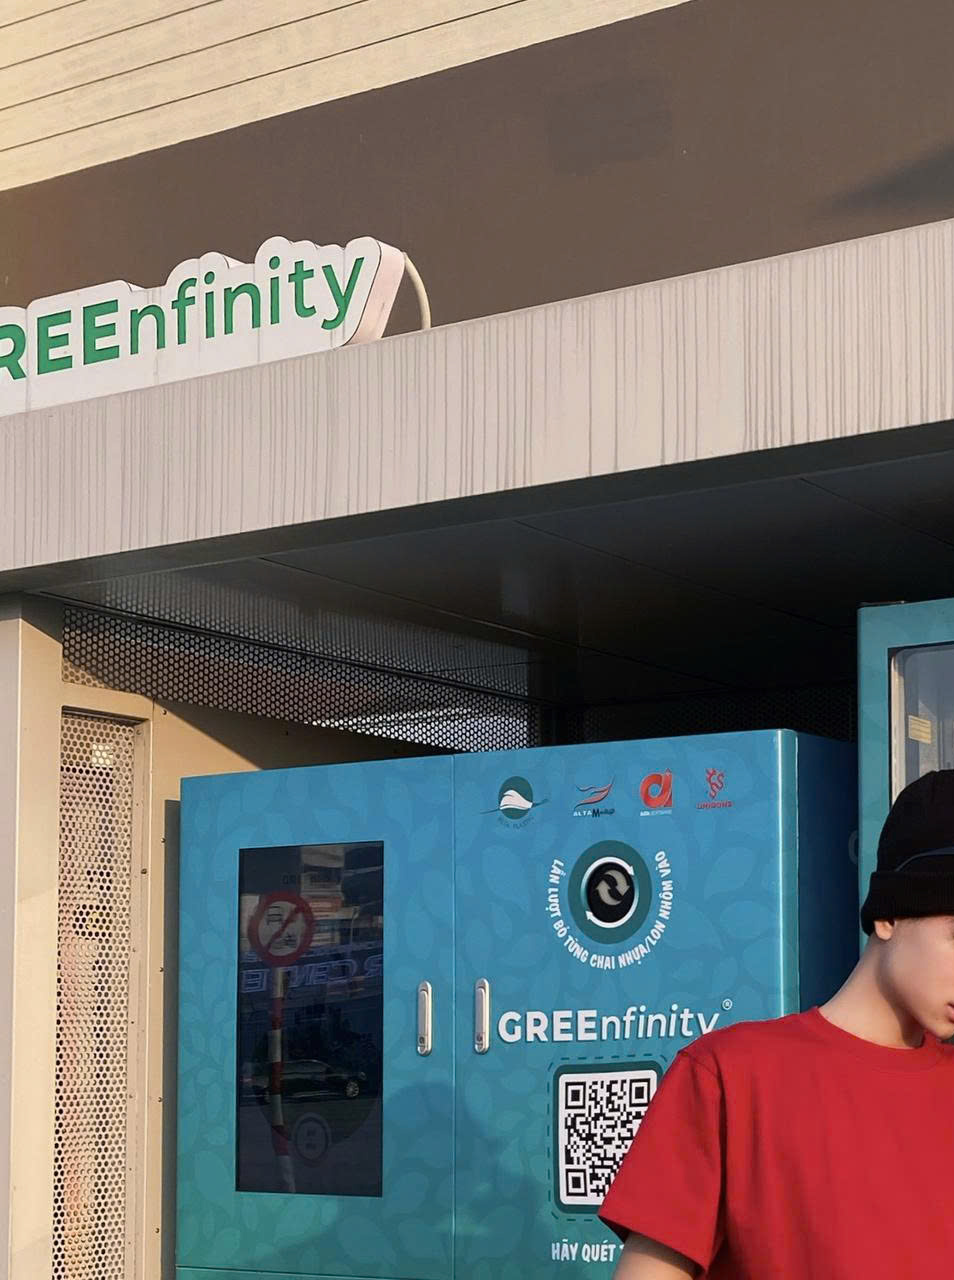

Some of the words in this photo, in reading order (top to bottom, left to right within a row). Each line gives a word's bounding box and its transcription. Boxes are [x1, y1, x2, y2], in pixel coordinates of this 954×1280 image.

[589, 954, 616, 970] CHAI
[551, 1238, 579, 1261] HÃY
[581, 1239, 617, 1263] QUÉT
